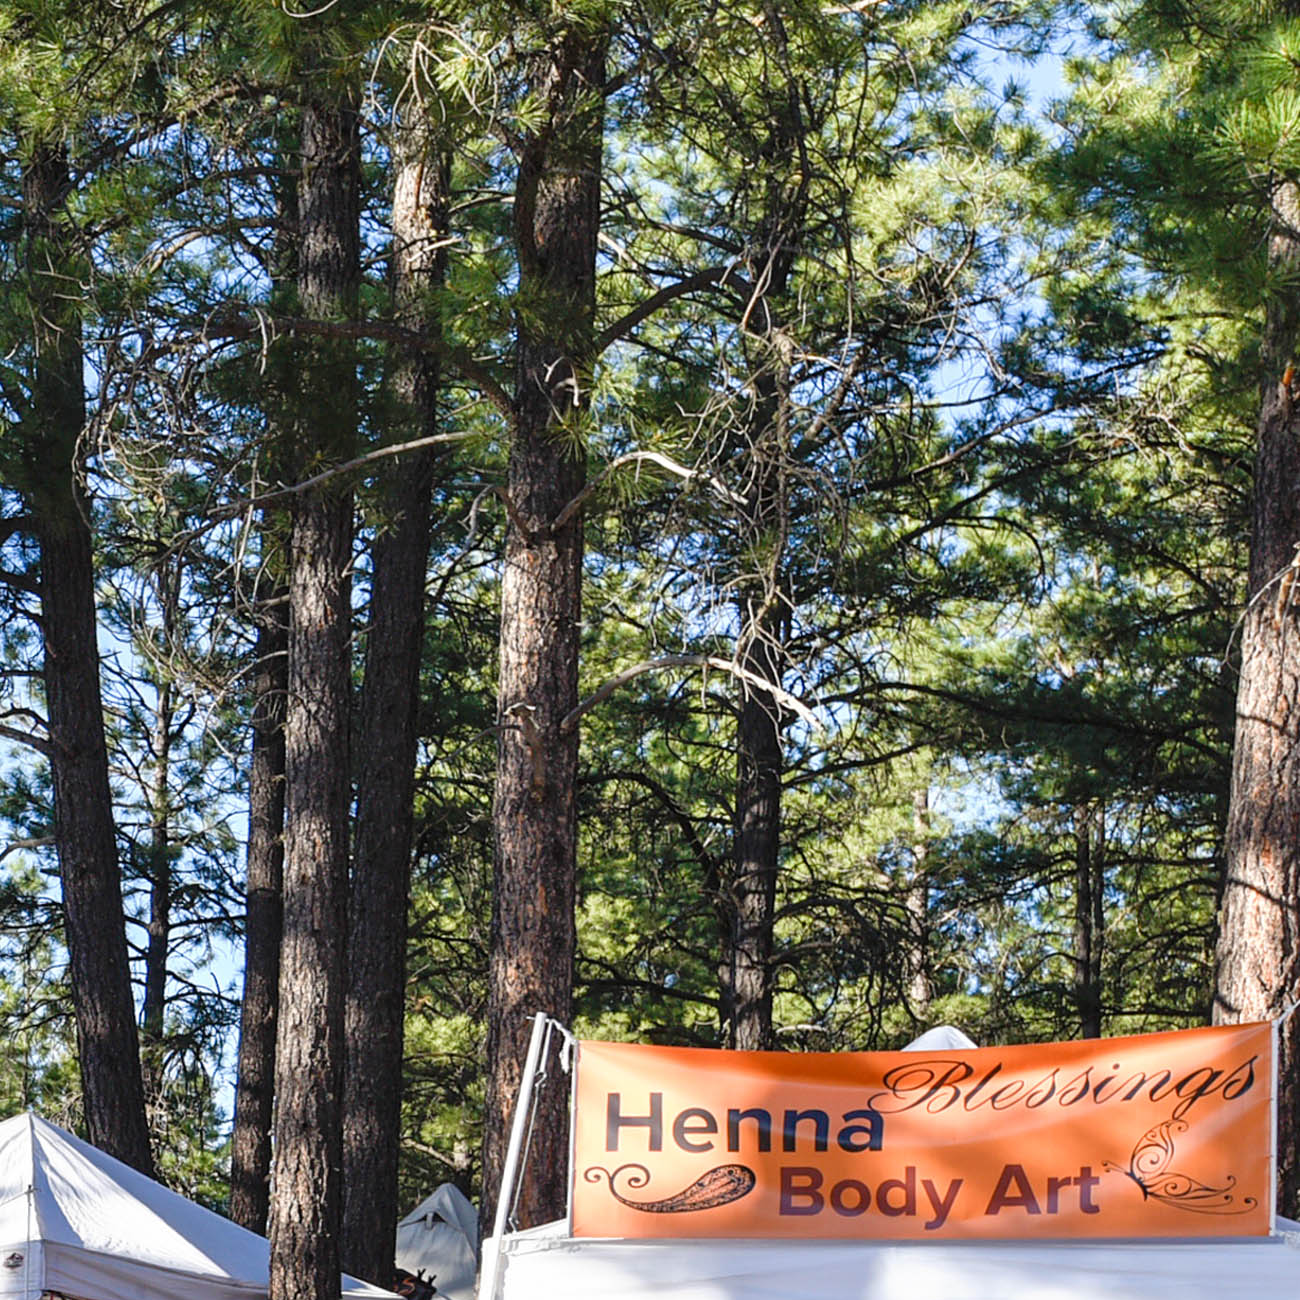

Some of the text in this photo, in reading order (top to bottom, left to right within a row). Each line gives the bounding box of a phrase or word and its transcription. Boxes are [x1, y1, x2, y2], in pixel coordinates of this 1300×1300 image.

[867, 1055, 1259, 1121] Blessings
[606, 1092, 885, 1153] Henna
[778, 1163, 1102, 1231] Body Art
